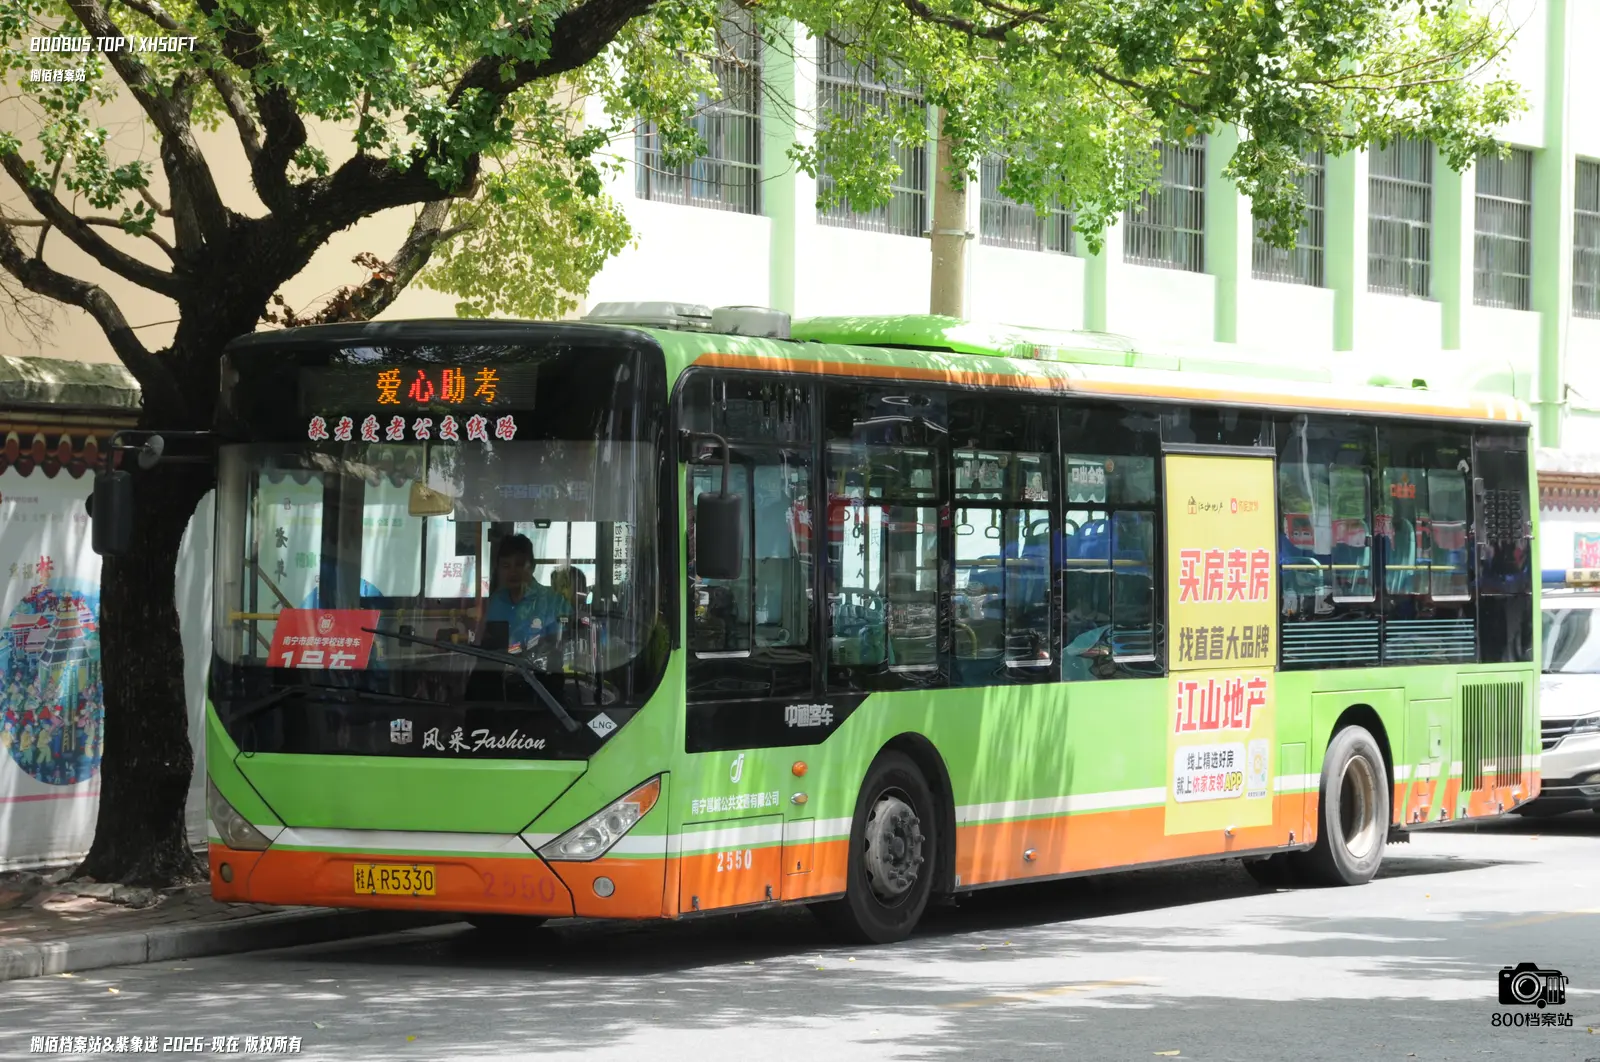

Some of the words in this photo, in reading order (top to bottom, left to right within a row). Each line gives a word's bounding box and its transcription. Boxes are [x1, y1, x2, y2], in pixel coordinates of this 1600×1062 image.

[376, 367, 500, 404] 爱心助考
[308, 414, 518, 442] 敬老爱老公交线路
[1178, 548, 1270, 602] 买房卖房
[1179, 624, 1270, 662] 找直营大品牌
[784, 703, 834, 728] 中通客车
[1174, 677, 1268, 733] 江山地产
[422, 726, 470, 753] 风采
[471, 728, 546, 751] Fashion
[592, 721, 612, 730] LNG
[1187, 750, 1234, 770] 线上精选好房
[717, 850, 752, 873] 2550
[482, 871, 556, 903] 2550
